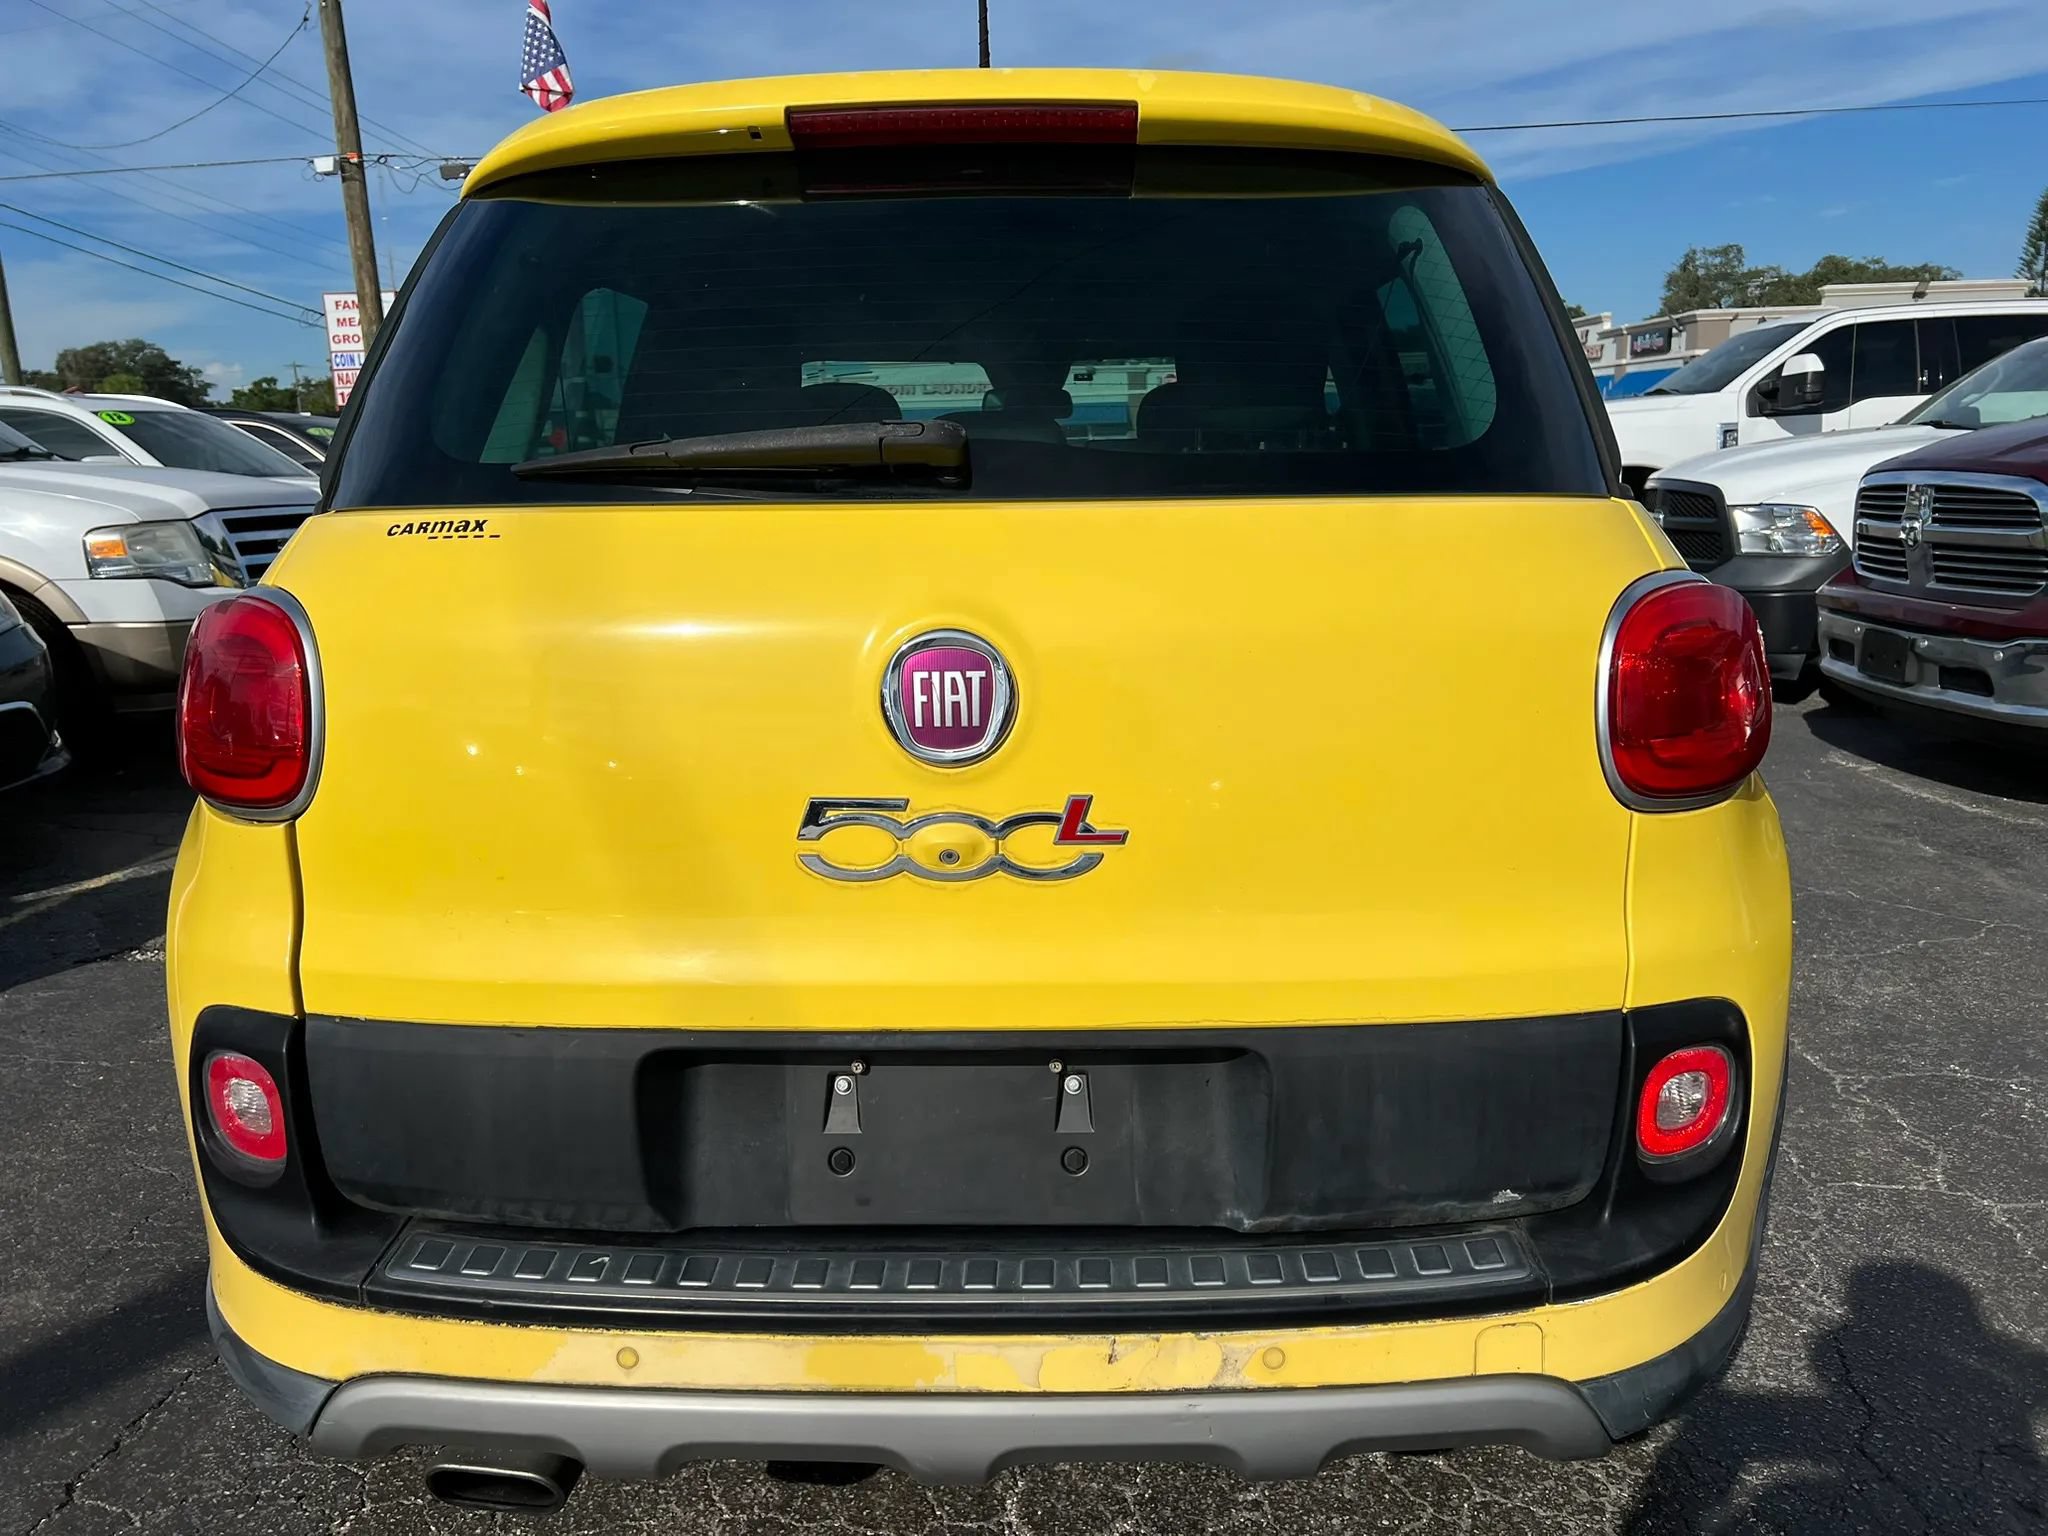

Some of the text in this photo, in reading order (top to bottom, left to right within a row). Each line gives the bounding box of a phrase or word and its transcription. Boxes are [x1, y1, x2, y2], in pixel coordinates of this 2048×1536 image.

[335, 300, 360, 310] FAM
[336, 317, 361, 327] ME
[332, 334, 361, 344] GRO
[334, 354, 355, 367] COIN
[885, 383, 989, 396] OIN LAUNDR
[912, 670, 986, 728] FIAT
[796, 794, 1131, 882] 500L
